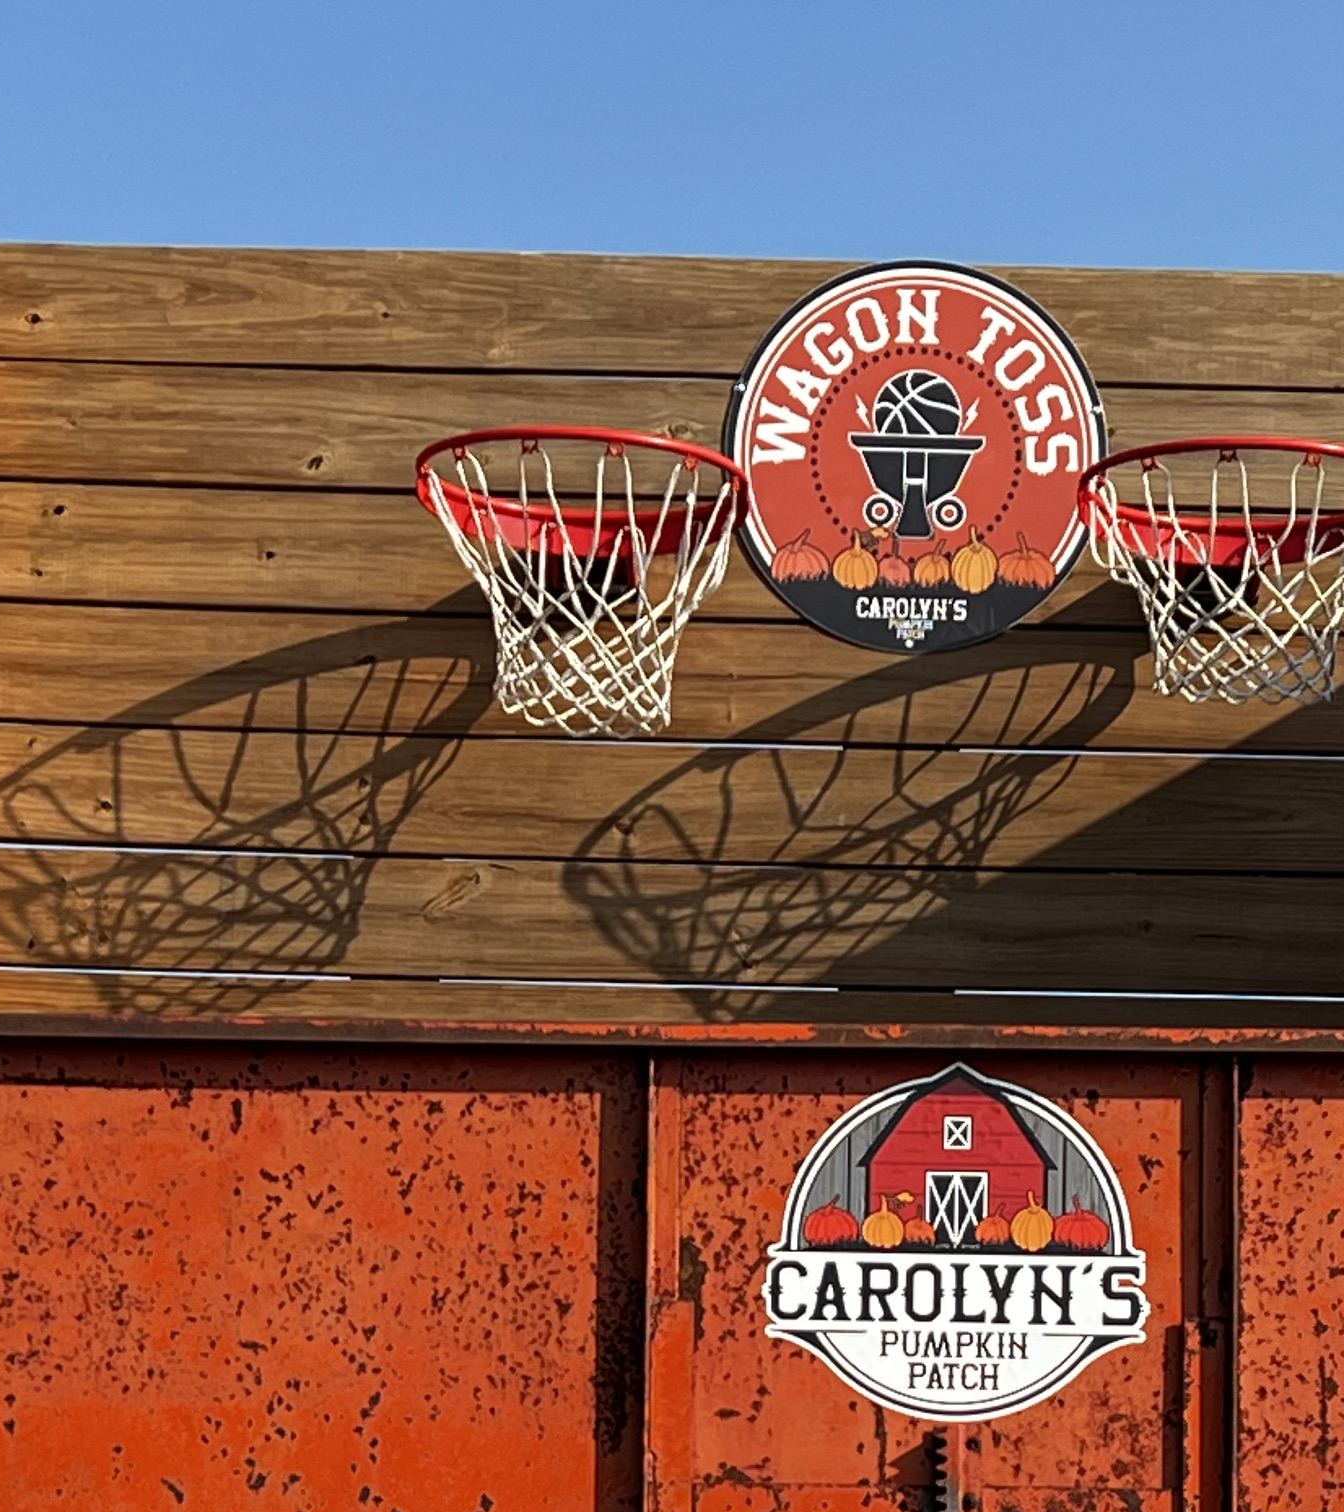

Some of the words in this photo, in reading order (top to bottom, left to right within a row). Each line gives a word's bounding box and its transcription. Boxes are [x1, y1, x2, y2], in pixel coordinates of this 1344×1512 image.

[752, 288, 942, 465] WAGON
[966, 305, 1080, 476] TOSS
[855, 595, 968, 621] CAROLYN'S
[767, 1260, 1146, 1327] CAROLYN'S
[879, 1329, 1030, 1360] PUMPKIN
[907, 1362, 1001, 1391] PATCH
